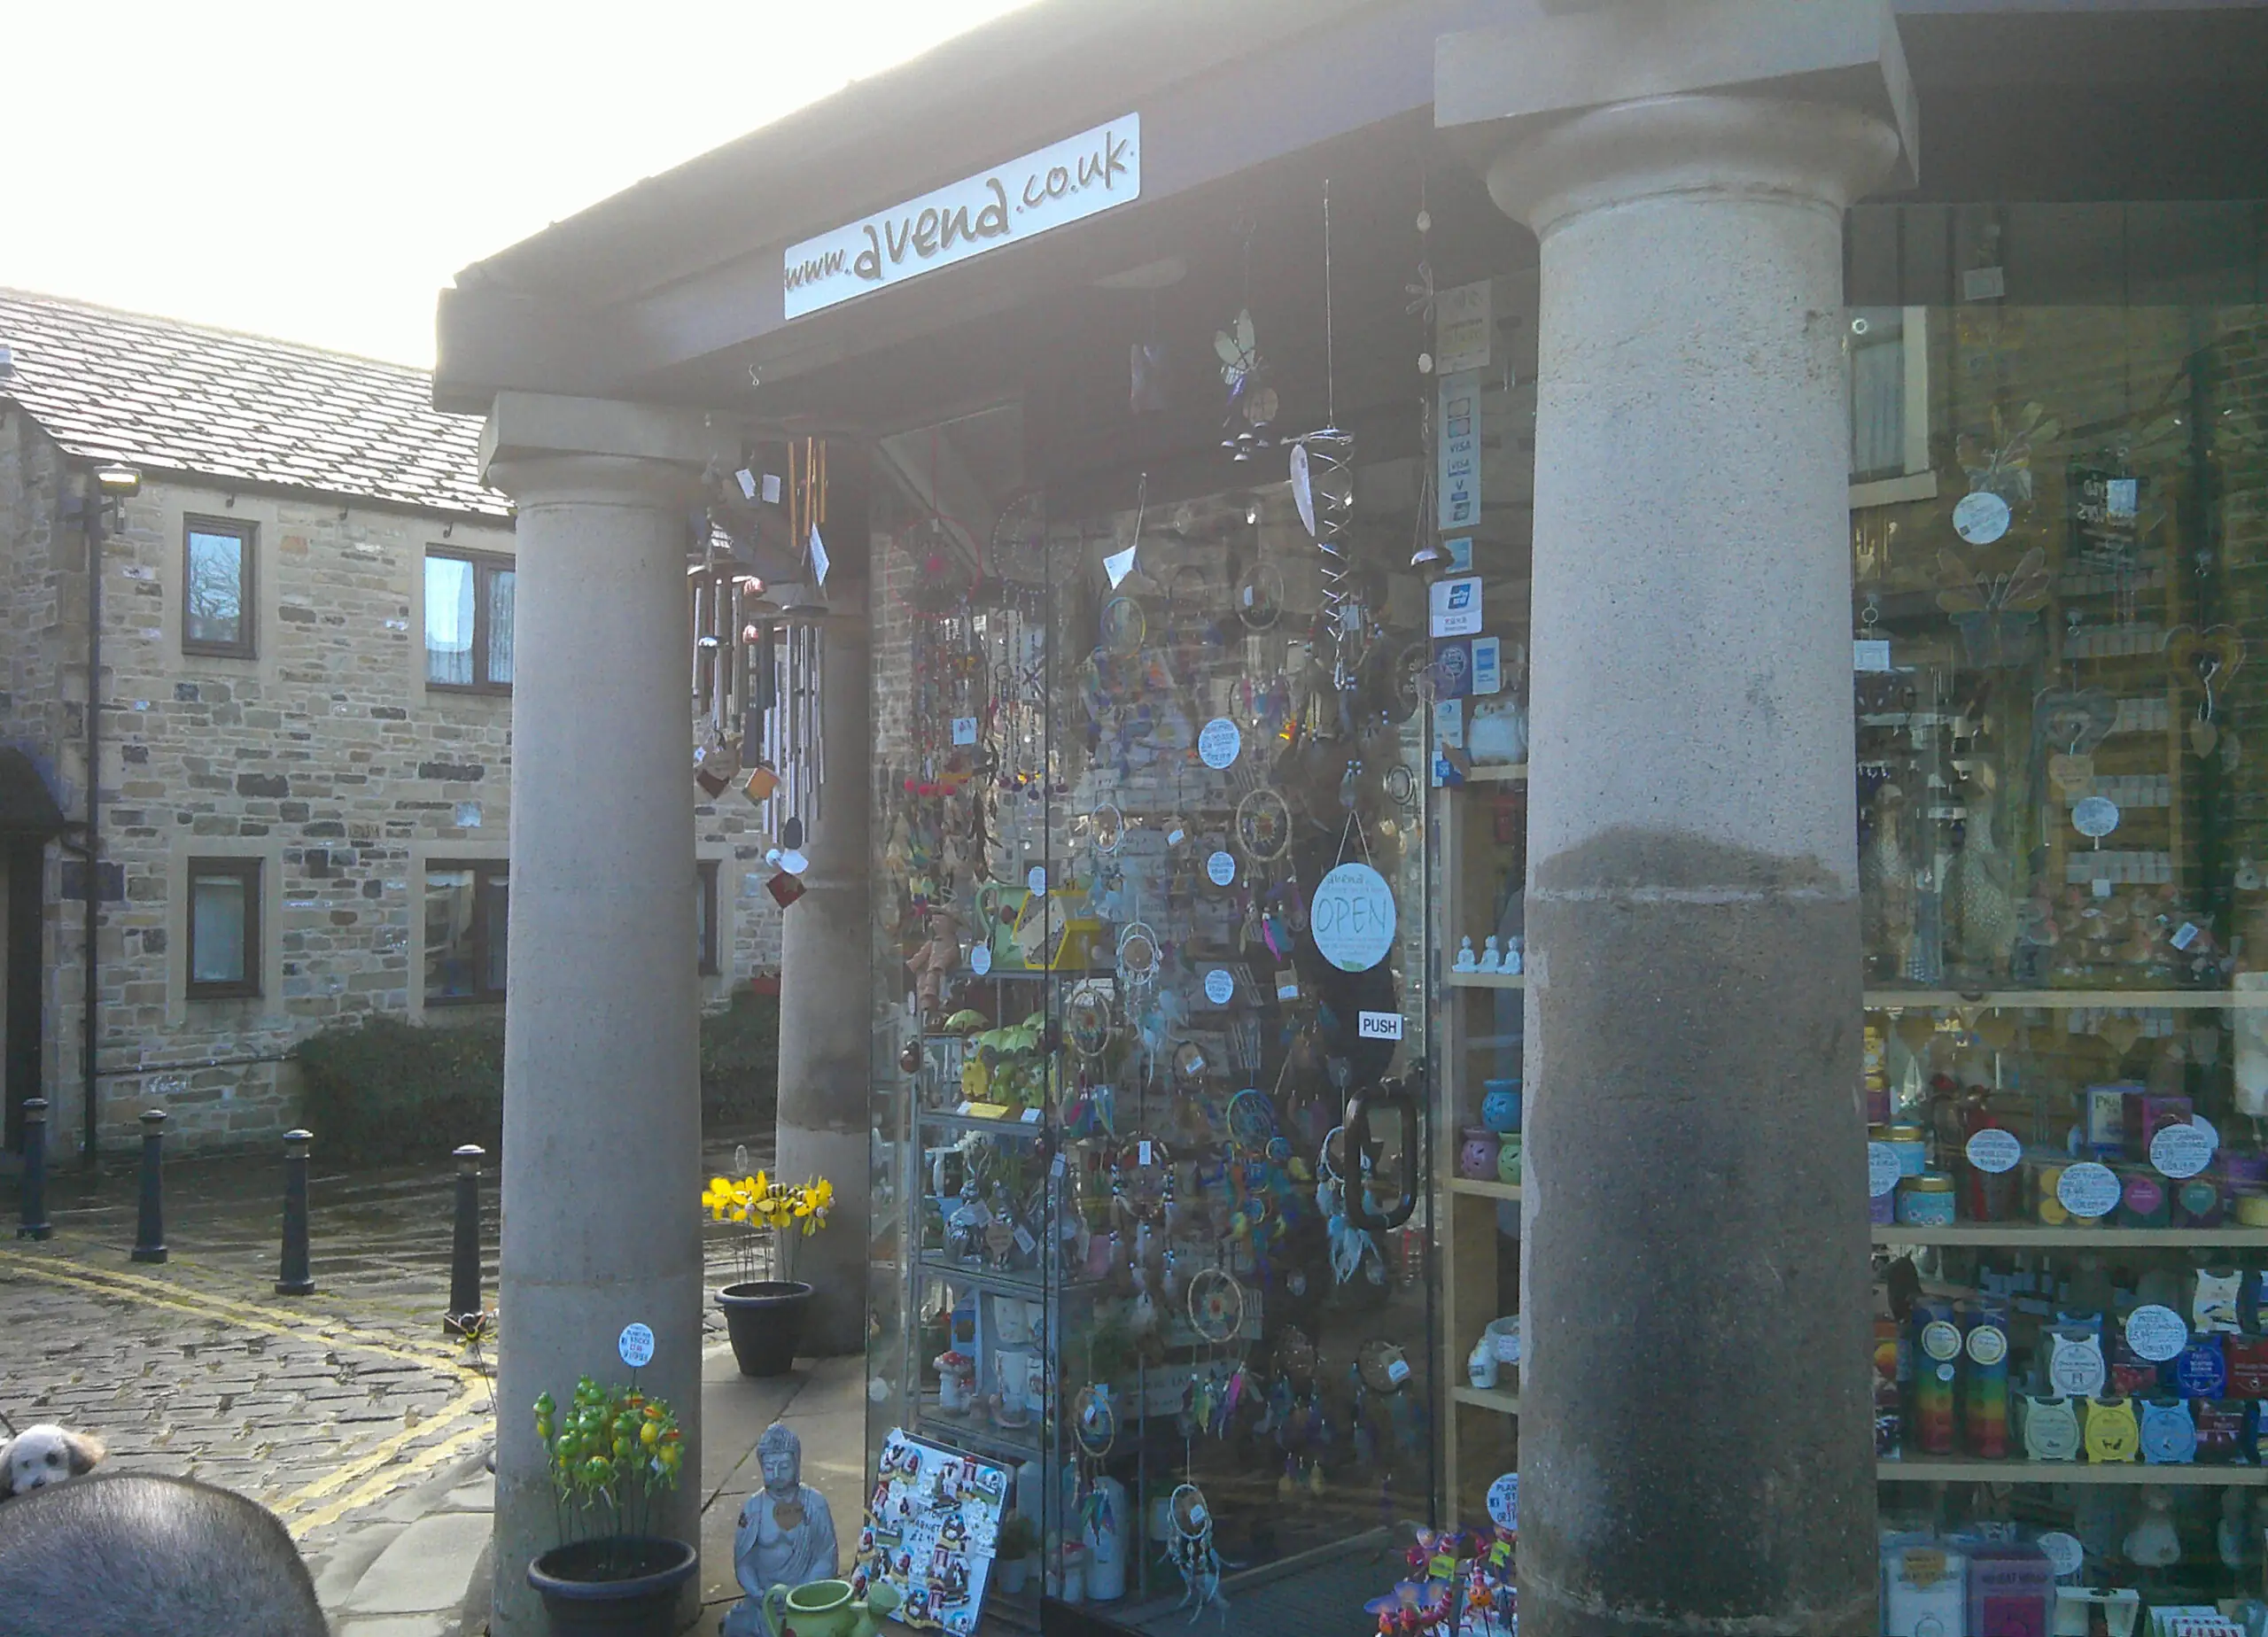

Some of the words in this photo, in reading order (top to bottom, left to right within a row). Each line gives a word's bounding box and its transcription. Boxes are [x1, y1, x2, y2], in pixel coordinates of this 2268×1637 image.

[785, 130, 1127, 291] www.avena.co.uk
[1450, 440, 1472, 453] VISA
[1317, 896, 1387, 934] OPEN
[1363, 1018, 1397, 1034] PUSH
[1496, 1483, 1518, 1492] PLAN
